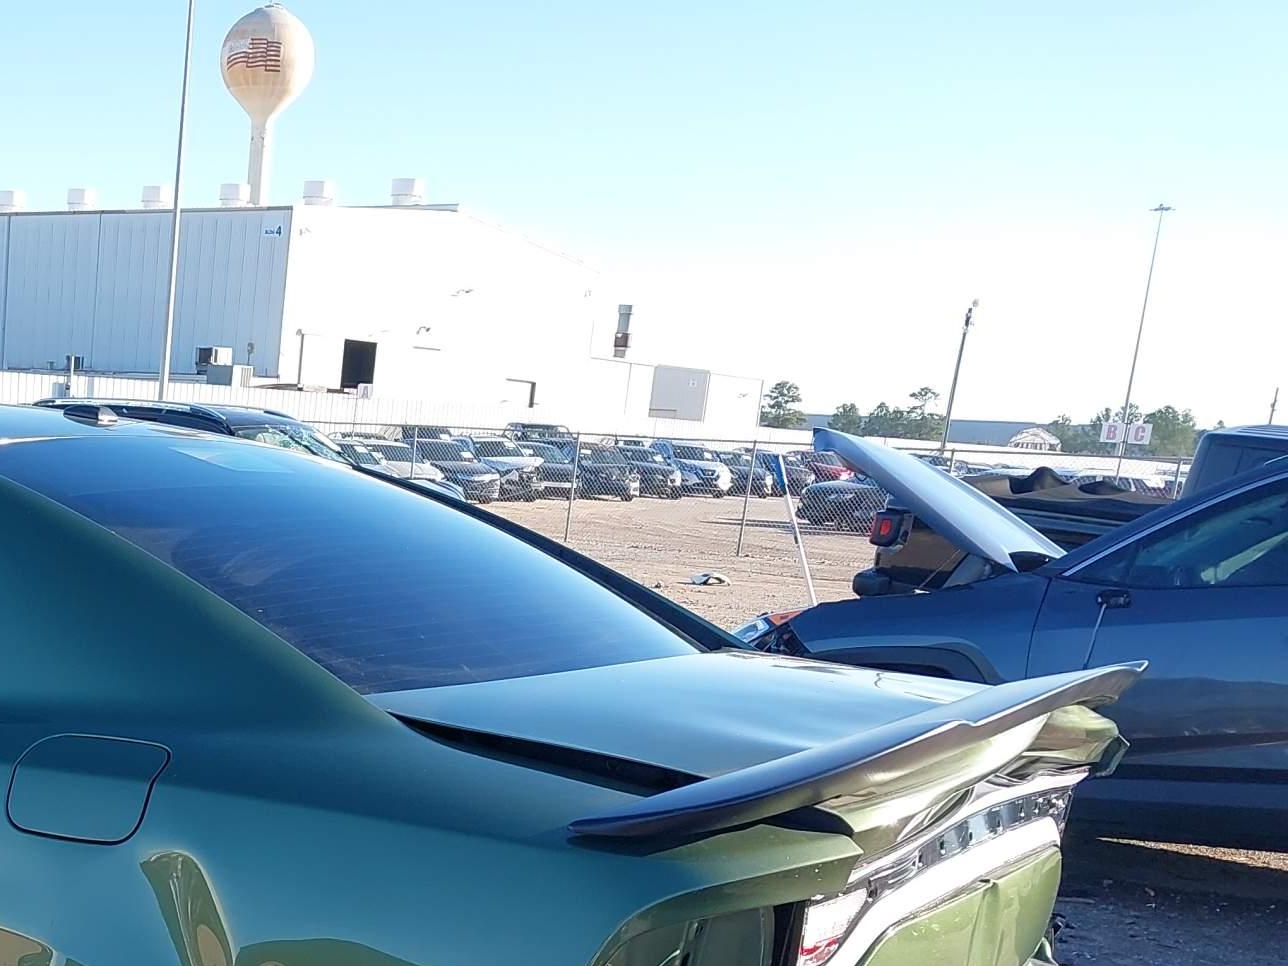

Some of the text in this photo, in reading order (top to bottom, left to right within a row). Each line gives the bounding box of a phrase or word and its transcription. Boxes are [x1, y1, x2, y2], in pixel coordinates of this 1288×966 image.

[275, 225, 282, 237] 4
[1106, 424, 1118, 441] B
[1133, 425, 1146, 442] C
